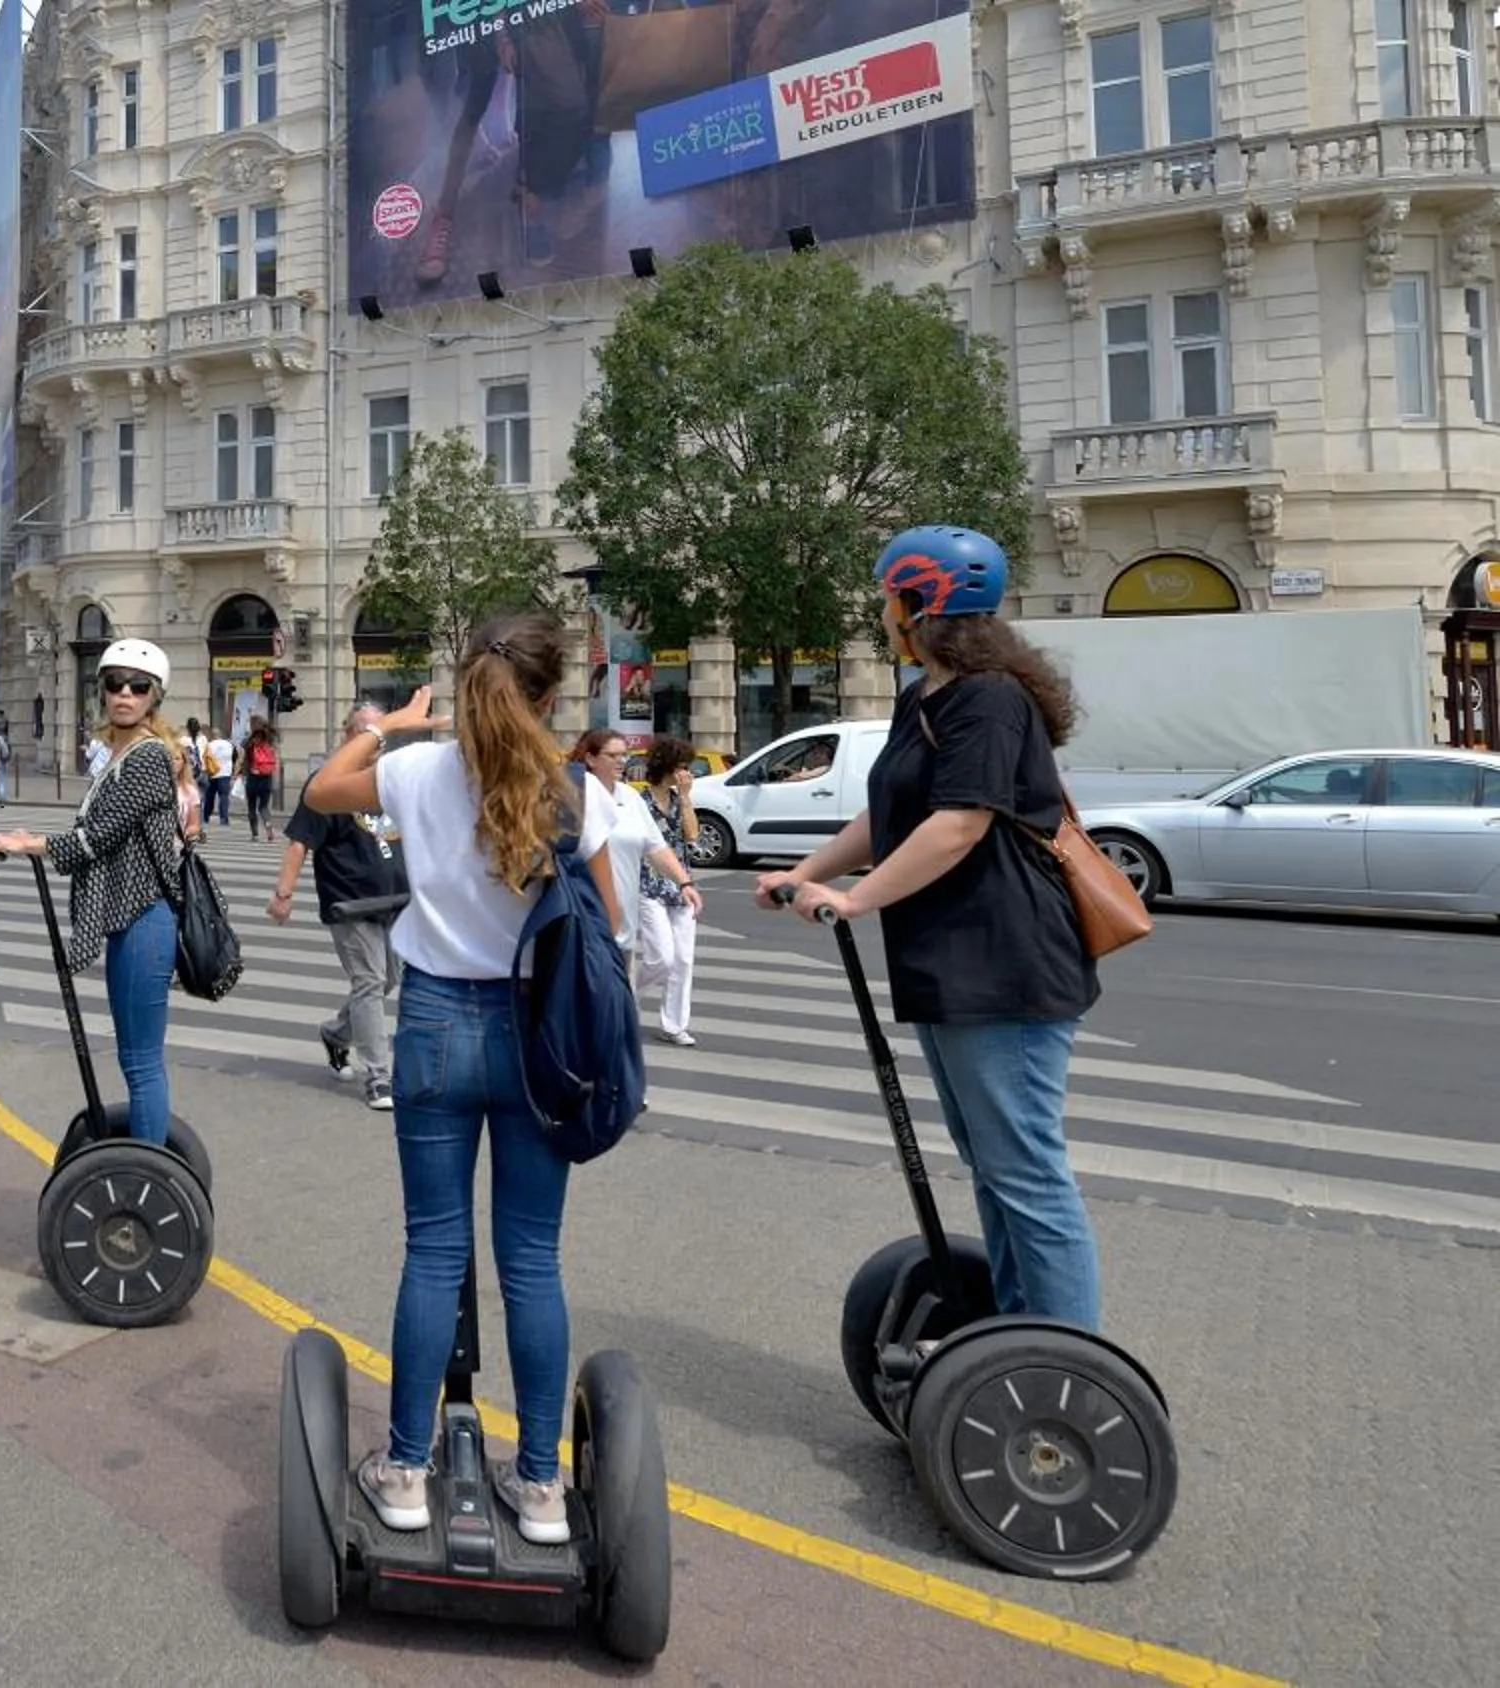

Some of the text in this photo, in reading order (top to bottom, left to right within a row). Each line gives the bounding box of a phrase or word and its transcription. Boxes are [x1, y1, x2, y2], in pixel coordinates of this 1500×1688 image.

[426, 24, 476, 55] Szállj
[480, 18, 505, 36] be
[509, 12, 524, 25] a
[779, 66, 863, 106] WEST
[803, 90, 866, 123] END
